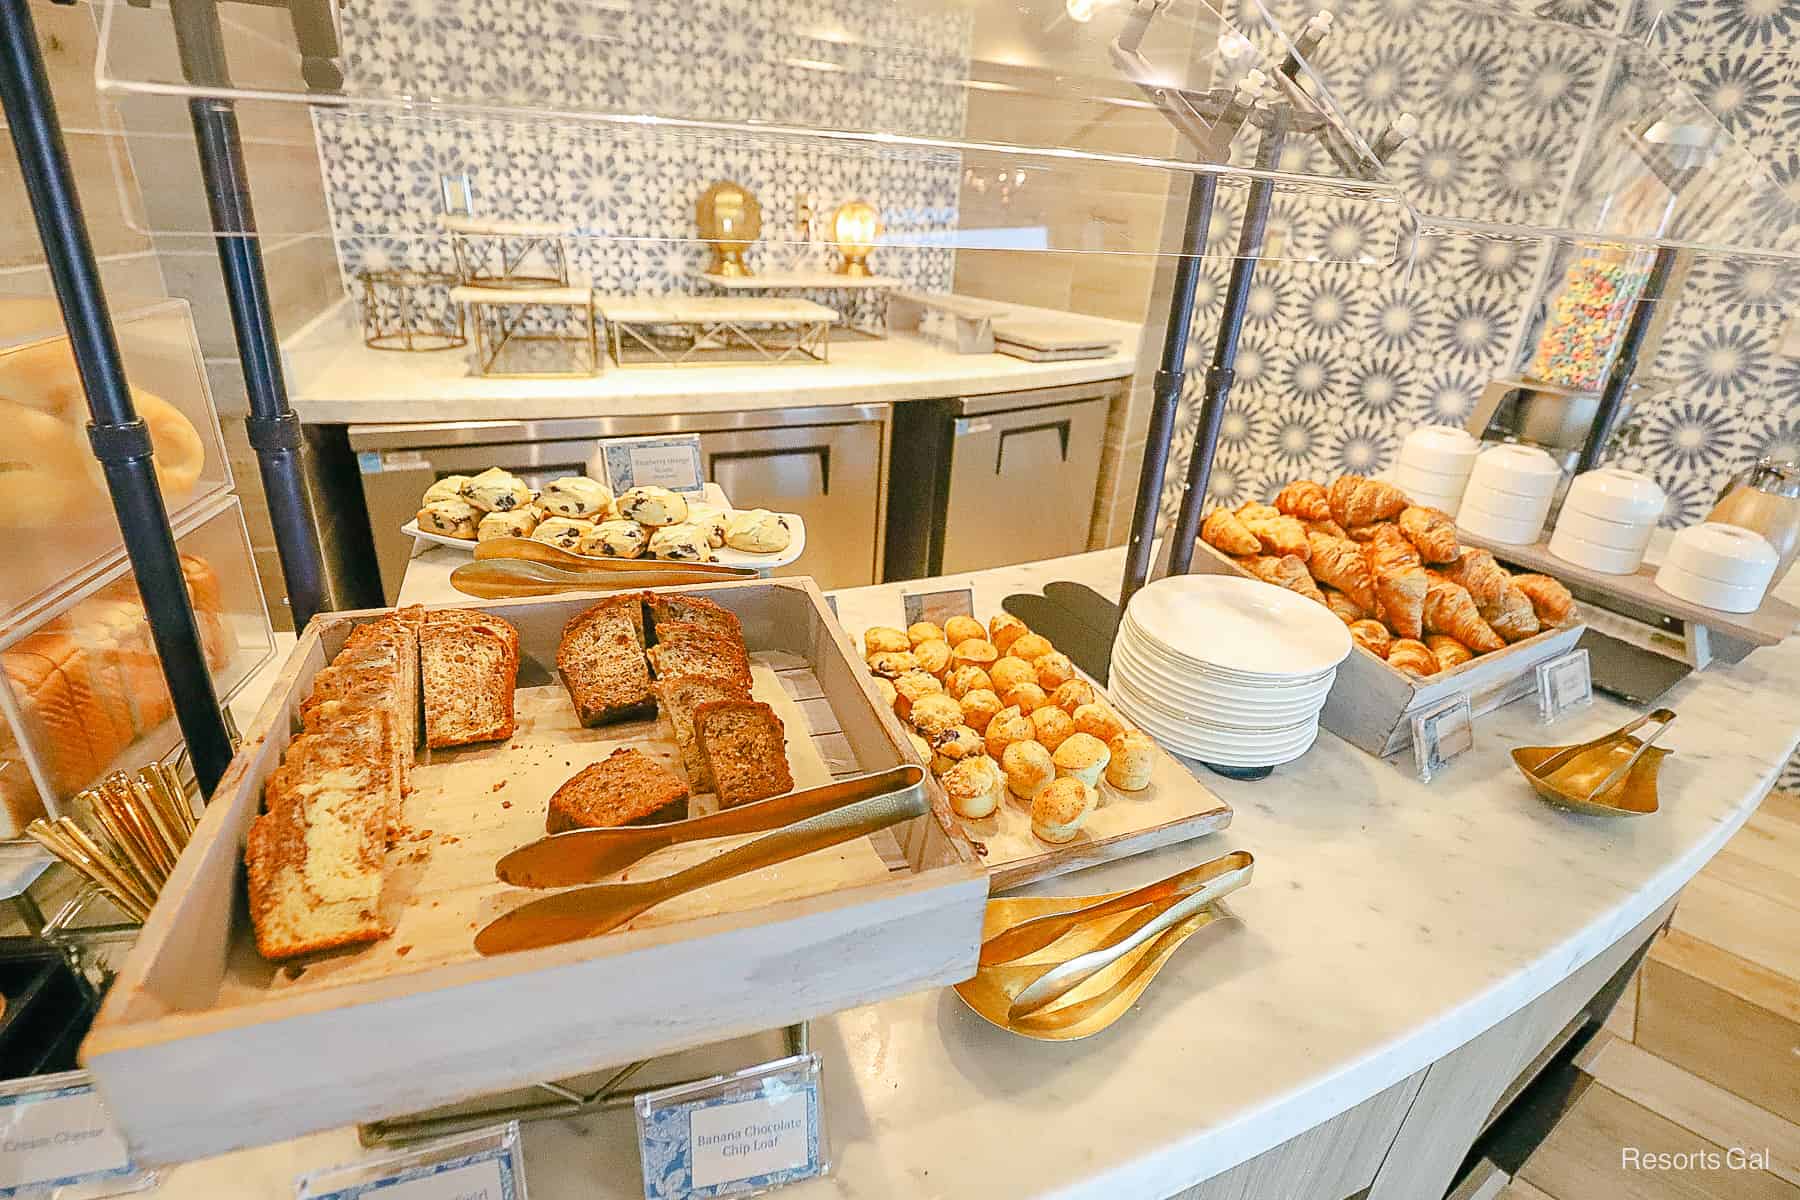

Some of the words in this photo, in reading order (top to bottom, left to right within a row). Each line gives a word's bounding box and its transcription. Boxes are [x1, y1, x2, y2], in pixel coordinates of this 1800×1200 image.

[698, 1129, 741, 1147] Banana
[744, 1118, 802, 1137] Chocolate
[722, 1143, 750, 1157] Chip
[753, 1137, 778, 1152] Loaf
